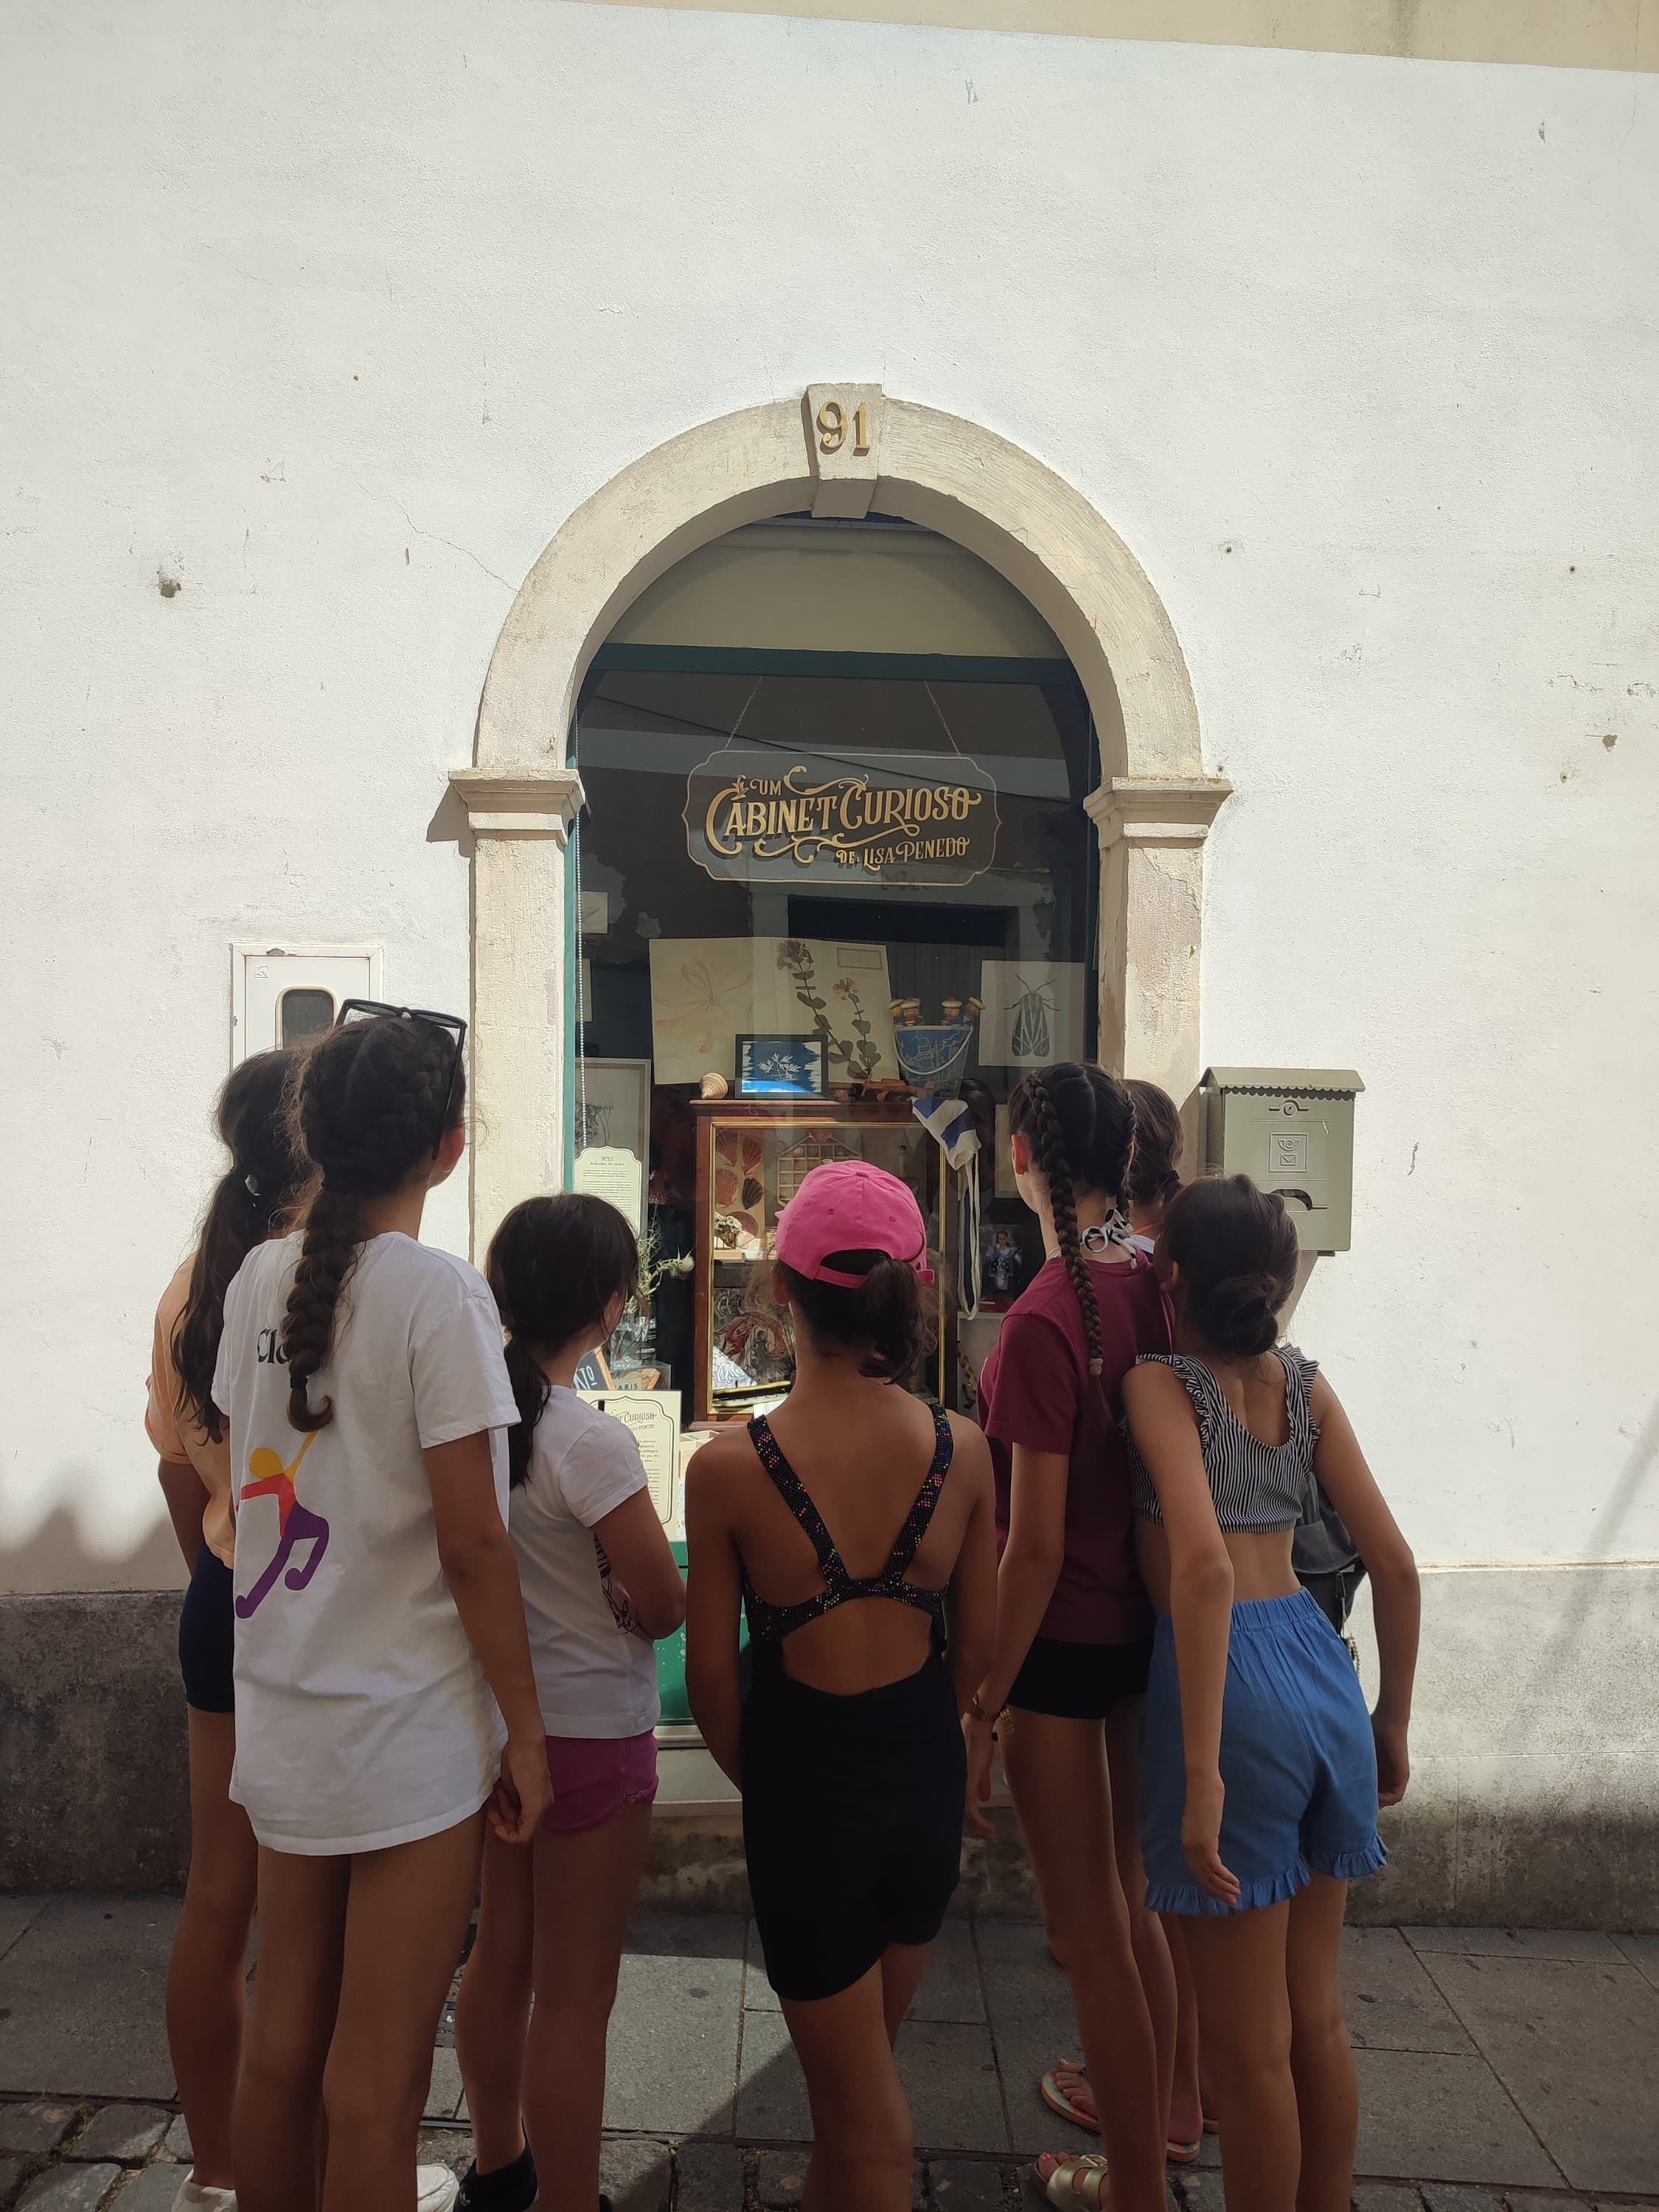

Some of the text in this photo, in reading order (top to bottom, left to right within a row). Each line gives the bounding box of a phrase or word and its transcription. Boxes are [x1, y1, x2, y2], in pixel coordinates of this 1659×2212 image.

[817, 400, 870, 450] 91
[750, 779, 782, 796] UM
[706, 785, 982, 855] CABINET CURIOSO
[836, 836, 970, 872] DE LISA PENEDO
